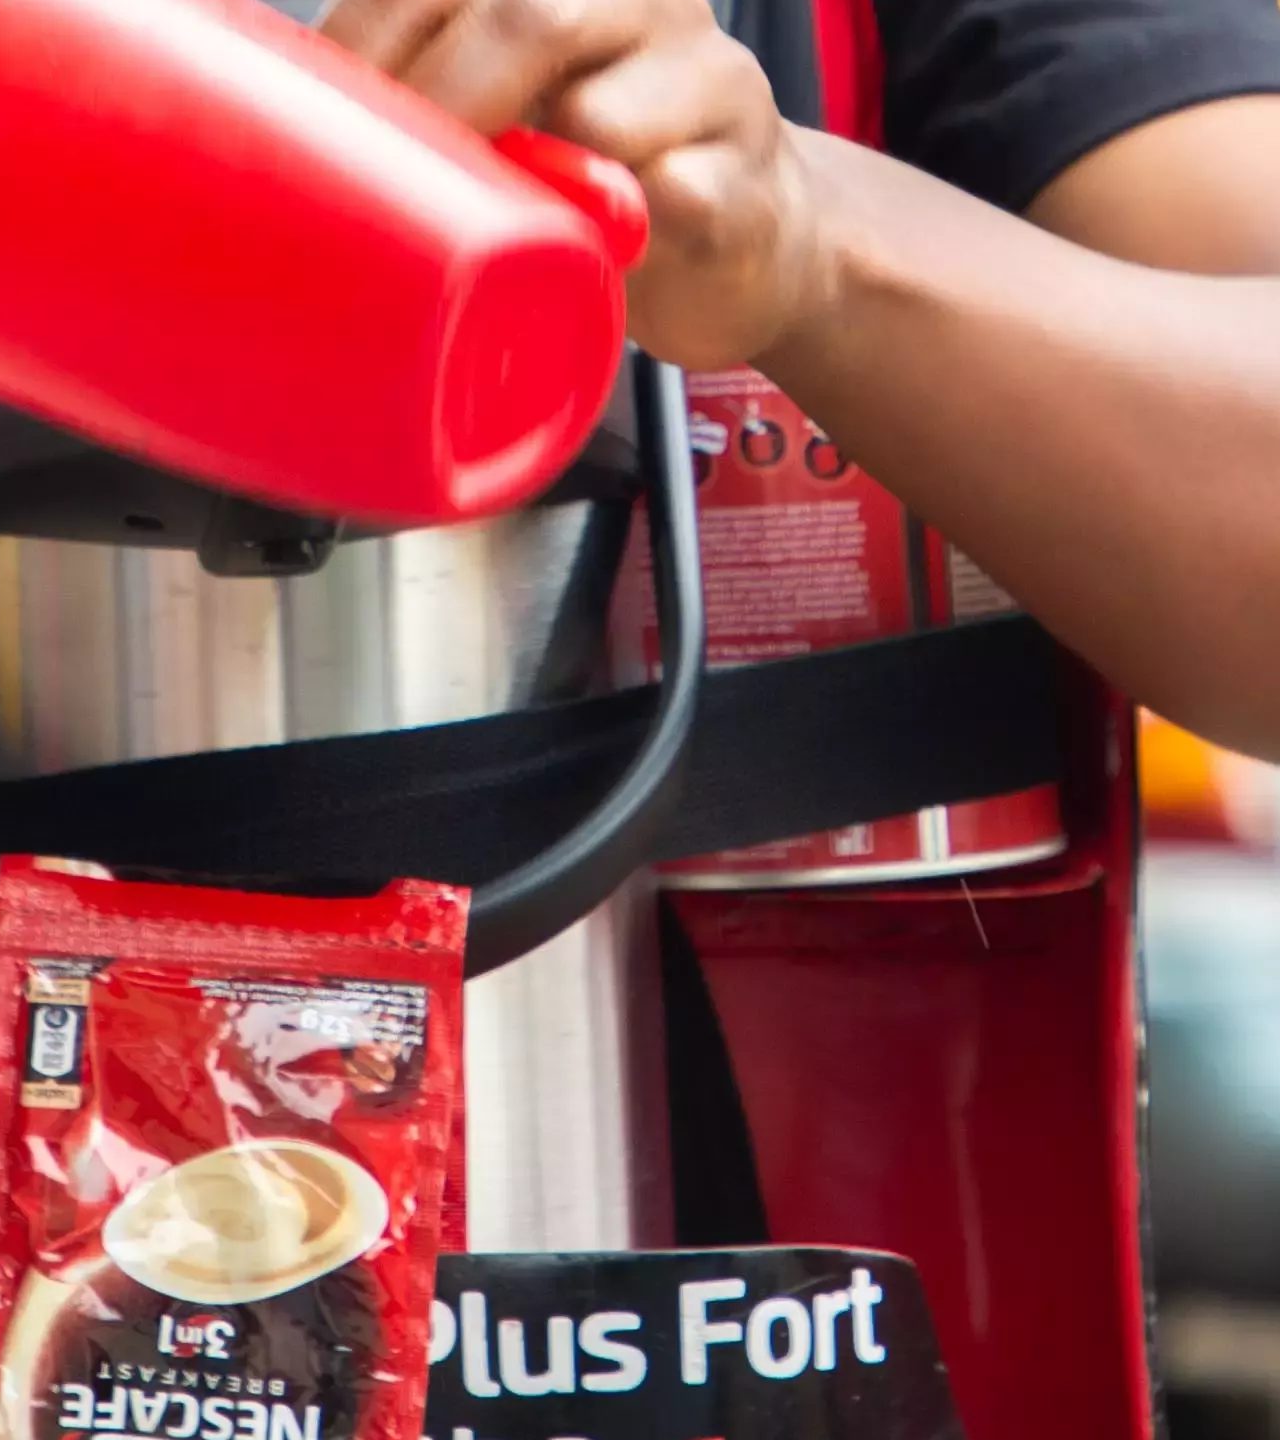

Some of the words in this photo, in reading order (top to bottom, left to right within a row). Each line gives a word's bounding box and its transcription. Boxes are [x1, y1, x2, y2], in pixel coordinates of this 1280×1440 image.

[156, 1314, 236, 1360] 3in1
[679, 1268, 885, 1386] Fort
[96, 1361, 285, 1397] BREAKFAST
